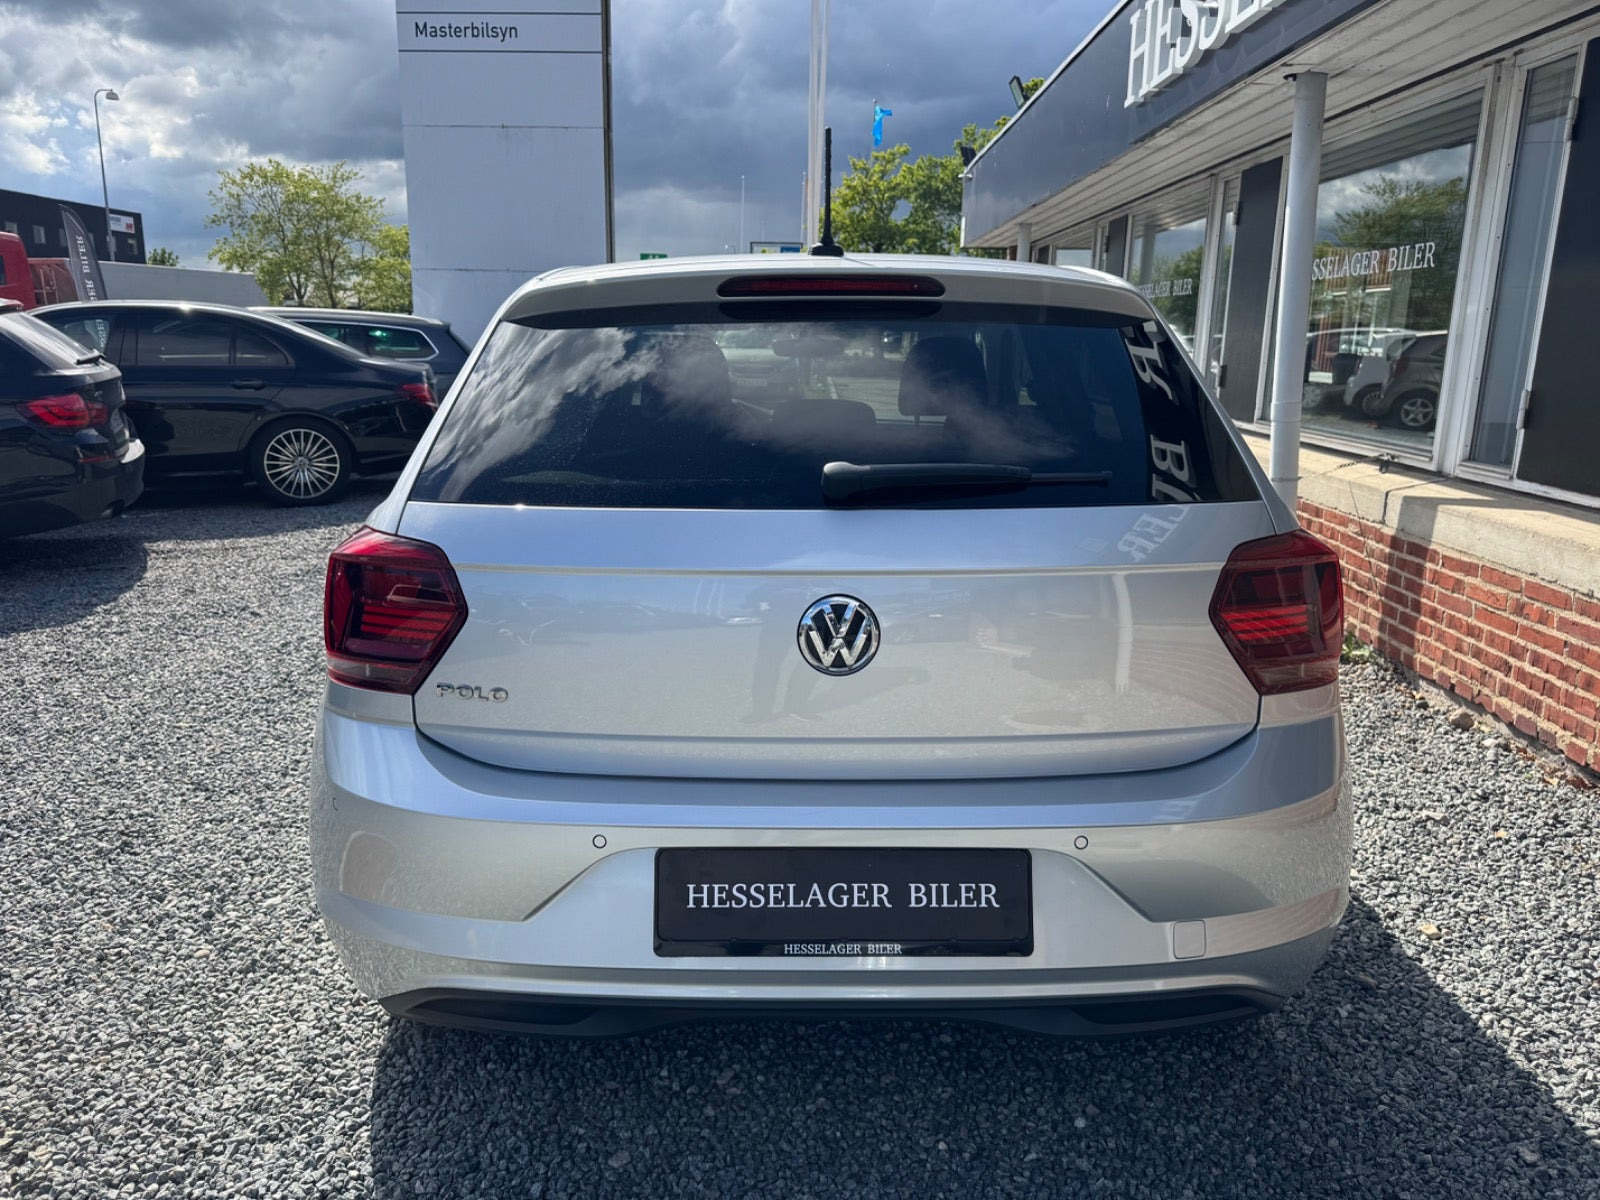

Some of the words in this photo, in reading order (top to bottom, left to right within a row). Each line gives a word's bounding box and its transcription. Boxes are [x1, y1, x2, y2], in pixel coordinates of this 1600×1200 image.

[414, 21, 518, 42] Masterbilsyn
[1386, 241, 1436, 272] BILER
[436, 682, 509, 703] POLO
[686, 883, 893, 909] HESSELAGER
[908, 883, 1000, 909] BILER
[783, 943, 862, 955] HESSELAGER
[867, 943, 903, 955] BILER
